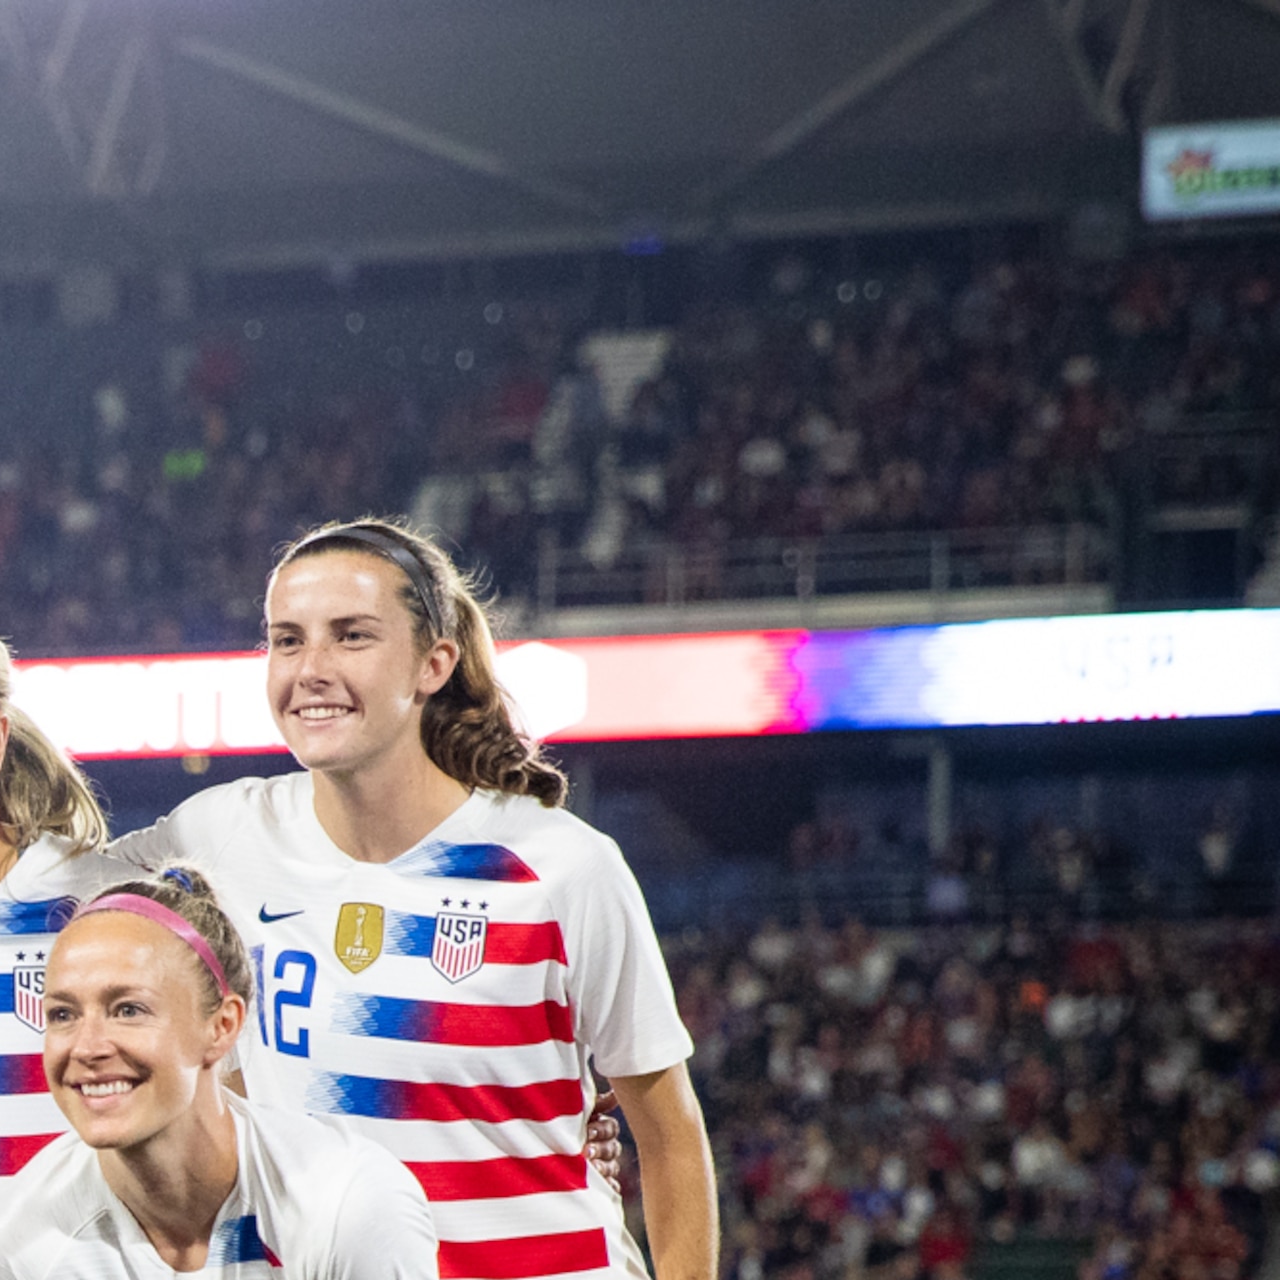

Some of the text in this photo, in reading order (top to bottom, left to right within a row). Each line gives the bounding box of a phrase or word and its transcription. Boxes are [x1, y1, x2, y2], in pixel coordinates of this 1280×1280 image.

[440, 916, 482, 944] USA
[345, 946, 369, 957] FIFA
[18, 970, 46, 994] US
[250, 944, 316, 1058] 12
